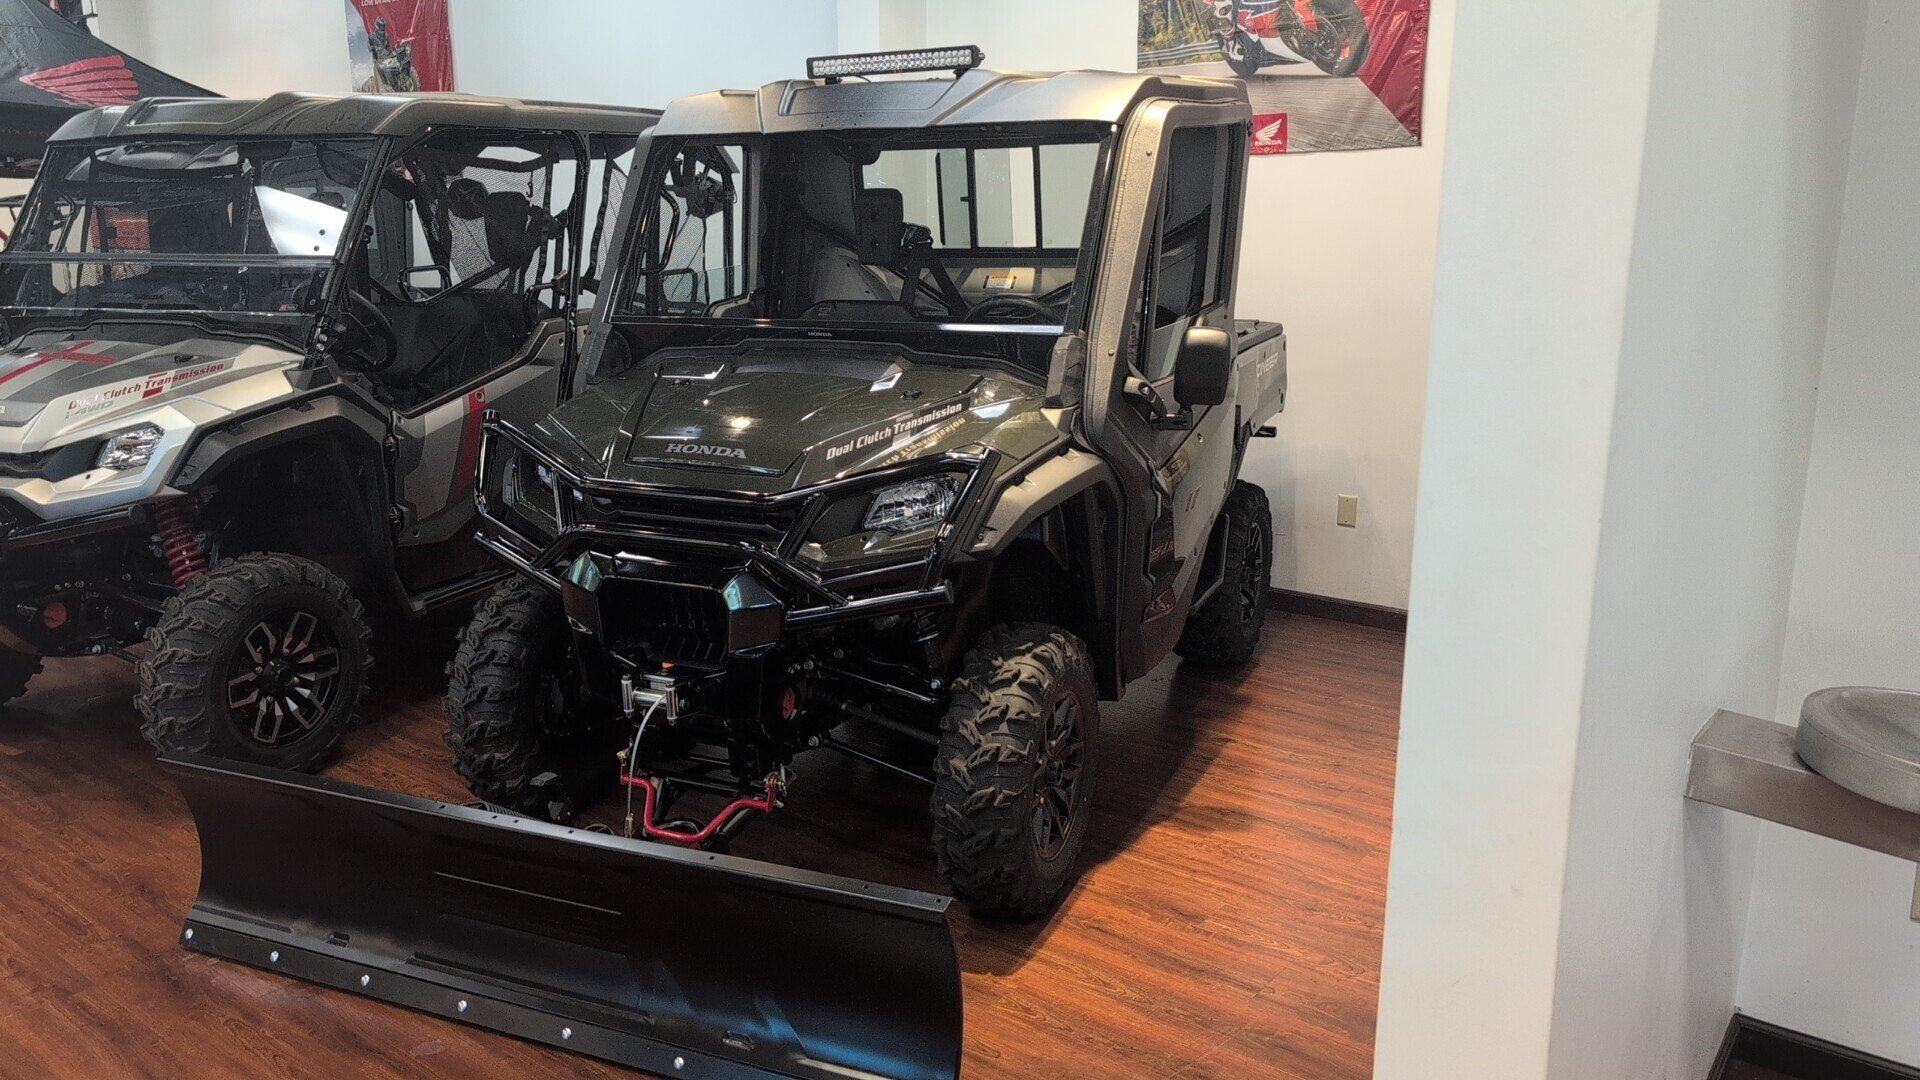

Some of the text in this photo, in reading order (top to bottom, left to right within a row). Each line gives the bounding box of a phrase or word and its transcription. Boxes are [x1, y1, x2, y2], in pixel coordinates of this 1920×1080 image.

[68, 362, 224, 410] Dual Clutch Transmission
[664, 443, 746, 459] HONDA
[826, 440, 854, 460] Dual
[856, 426, 892, 448] Clutch
[893, 402, 962, 435] Transmission
